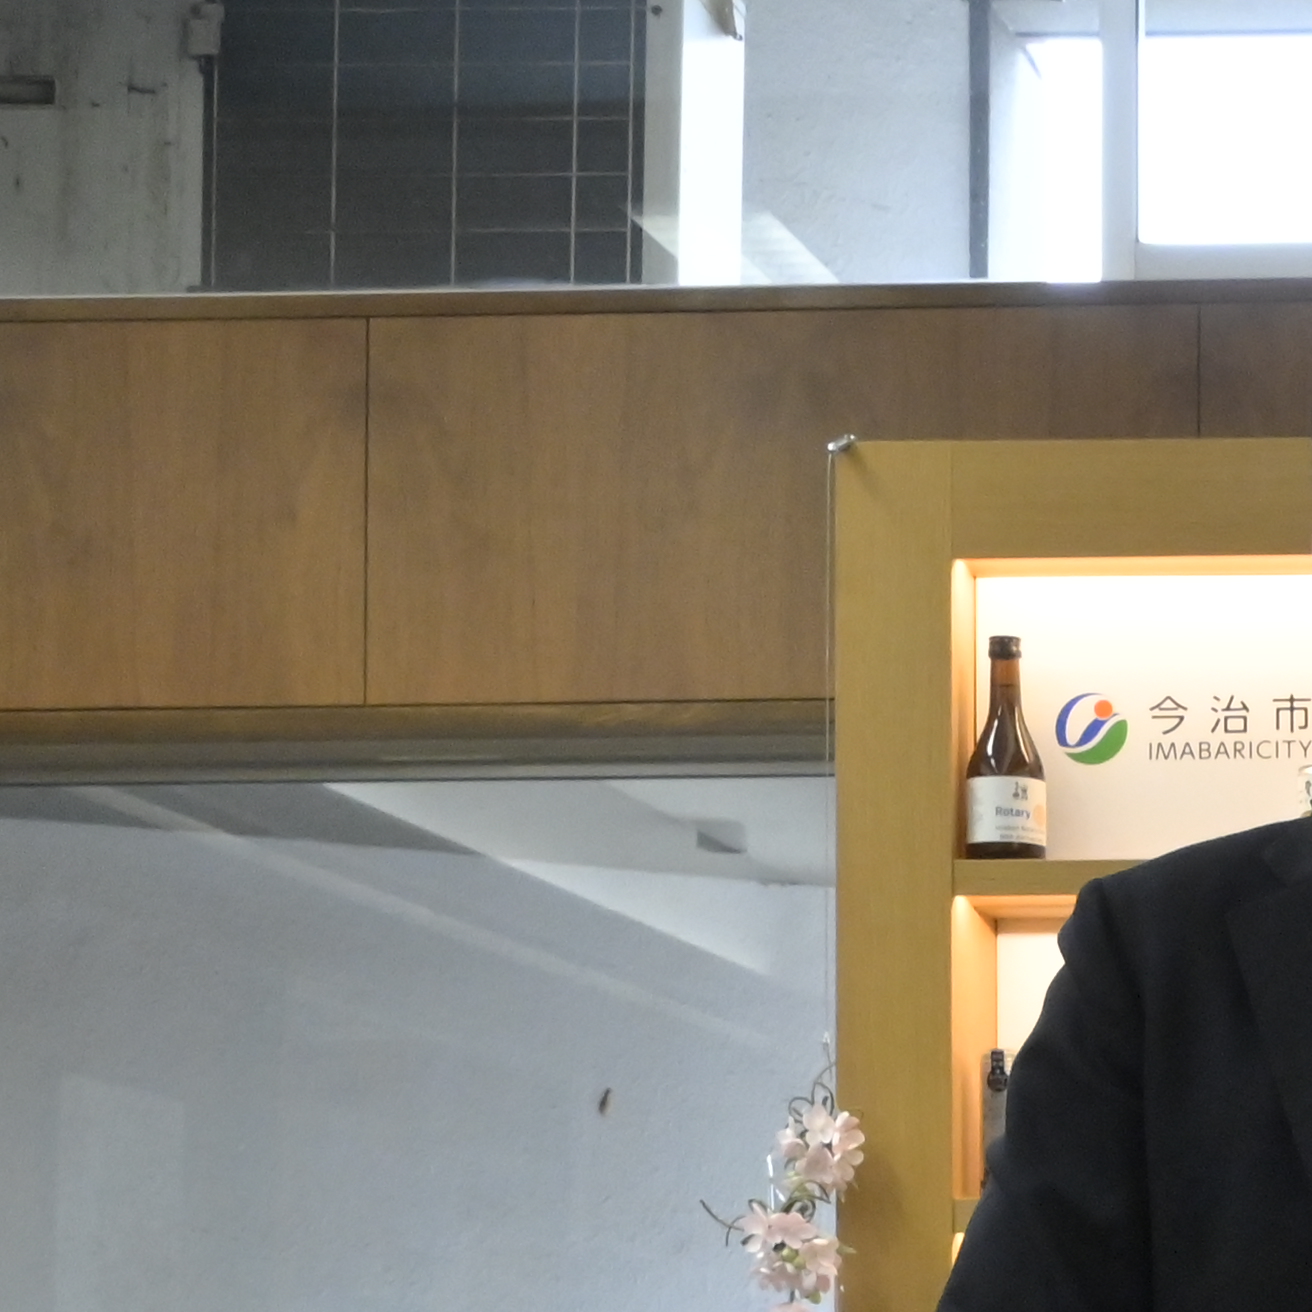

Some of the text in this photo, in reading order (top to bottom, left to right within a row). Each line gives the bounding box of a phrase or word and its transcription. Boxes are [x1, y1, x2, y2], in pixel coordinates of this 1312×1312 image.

[1147, 693, 1312, 736] 今治市
[995, 806, 1031, 821] Rotary
